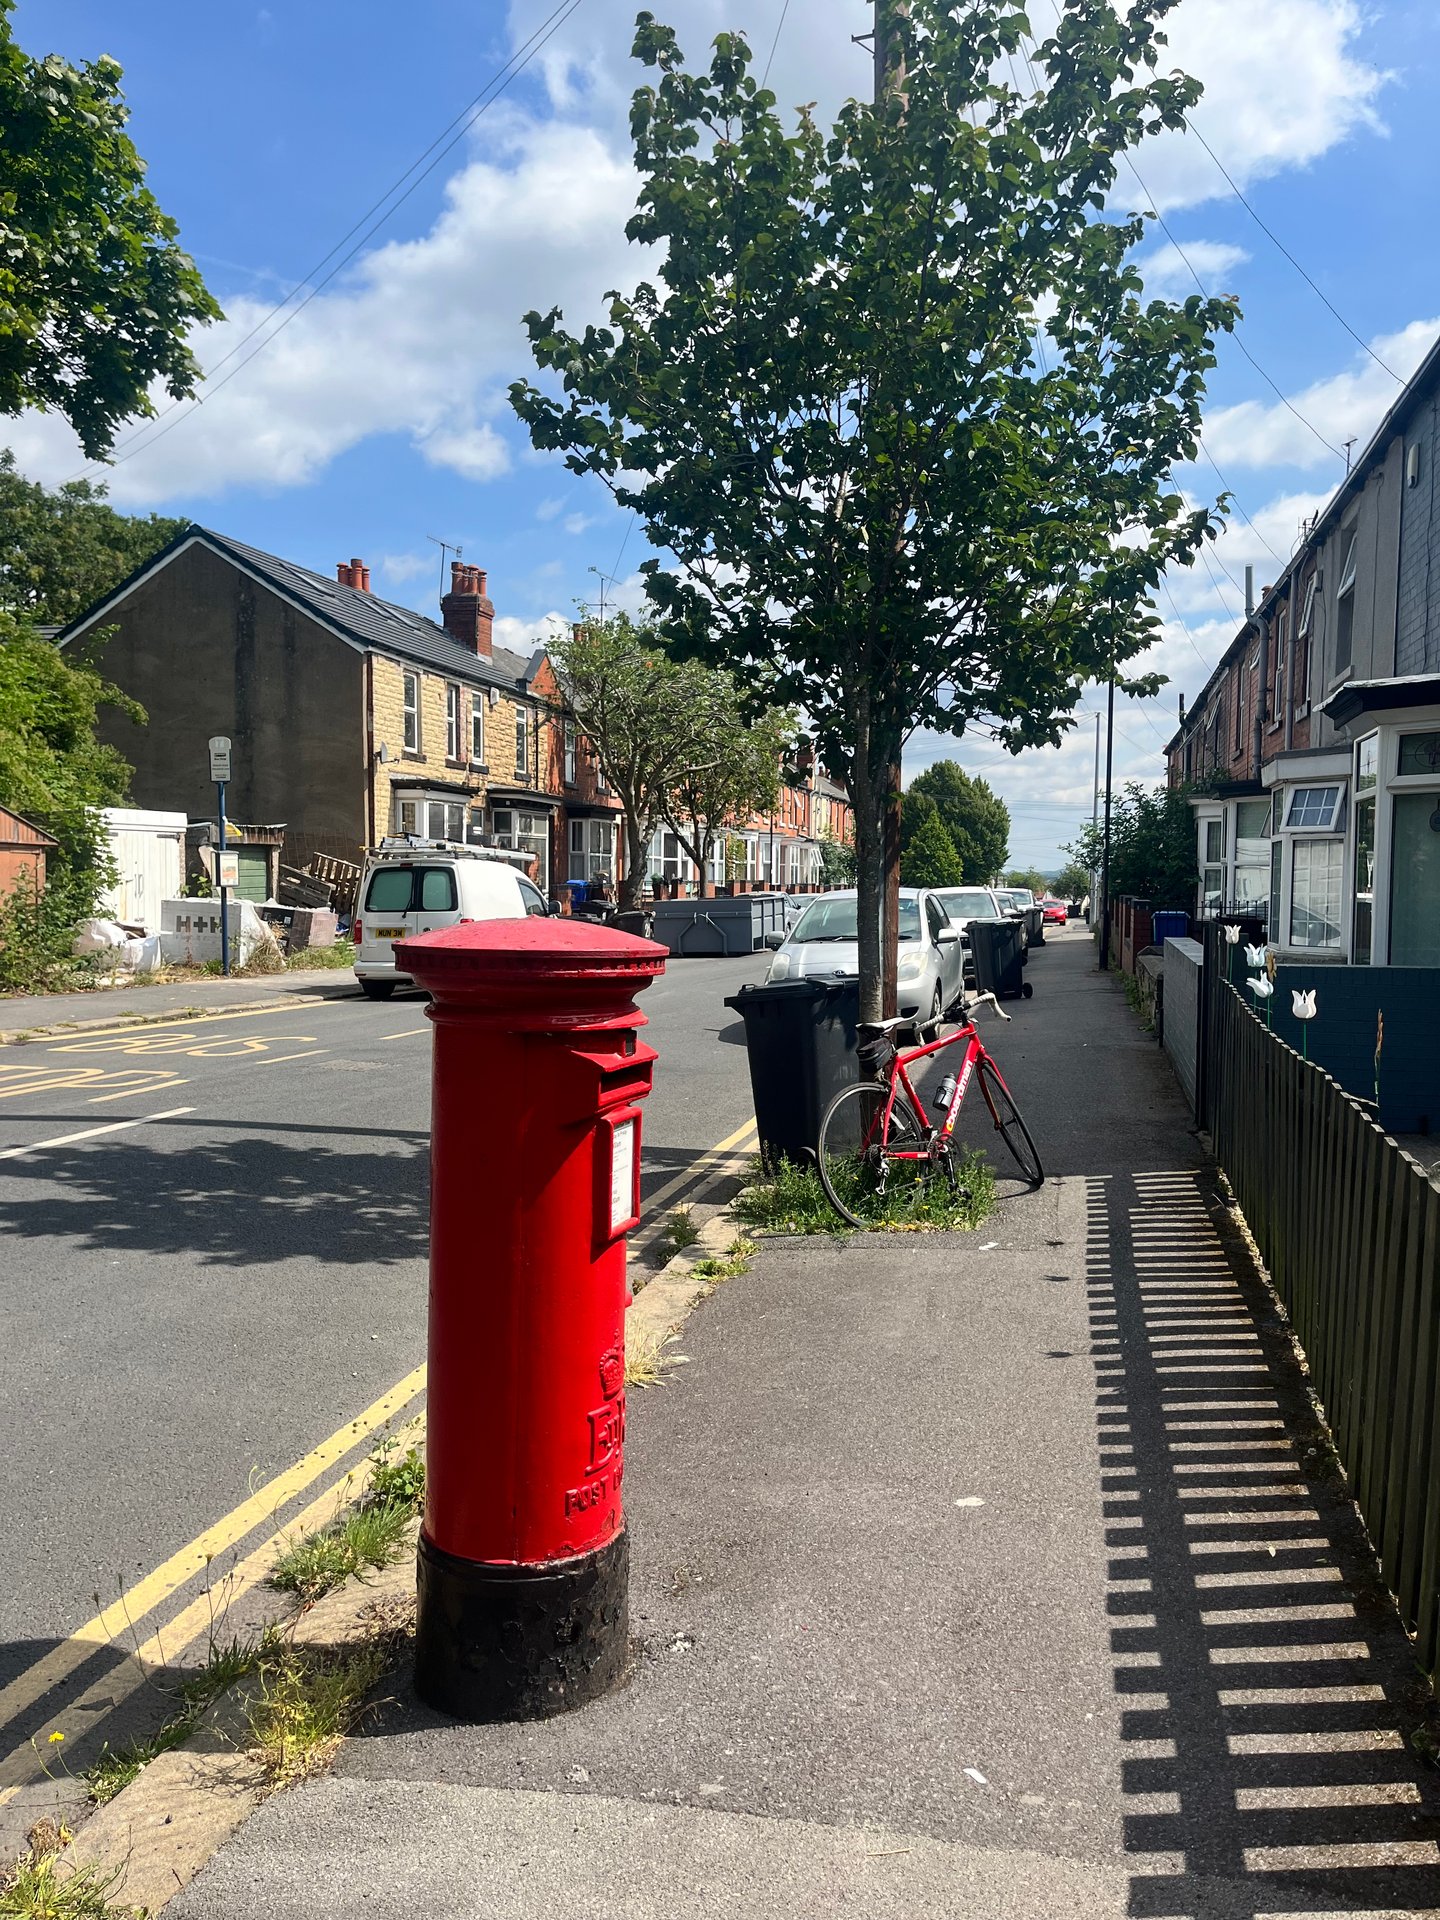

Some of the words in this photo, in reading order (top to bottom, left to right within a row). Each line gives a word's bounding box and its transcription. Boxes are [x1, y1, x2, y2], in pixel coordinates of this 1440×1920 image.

[47, 1034, 317, 1056] BUS
[946, 1060, 973, 1127] boardman
[565, 1475, 609, 1516] POST
